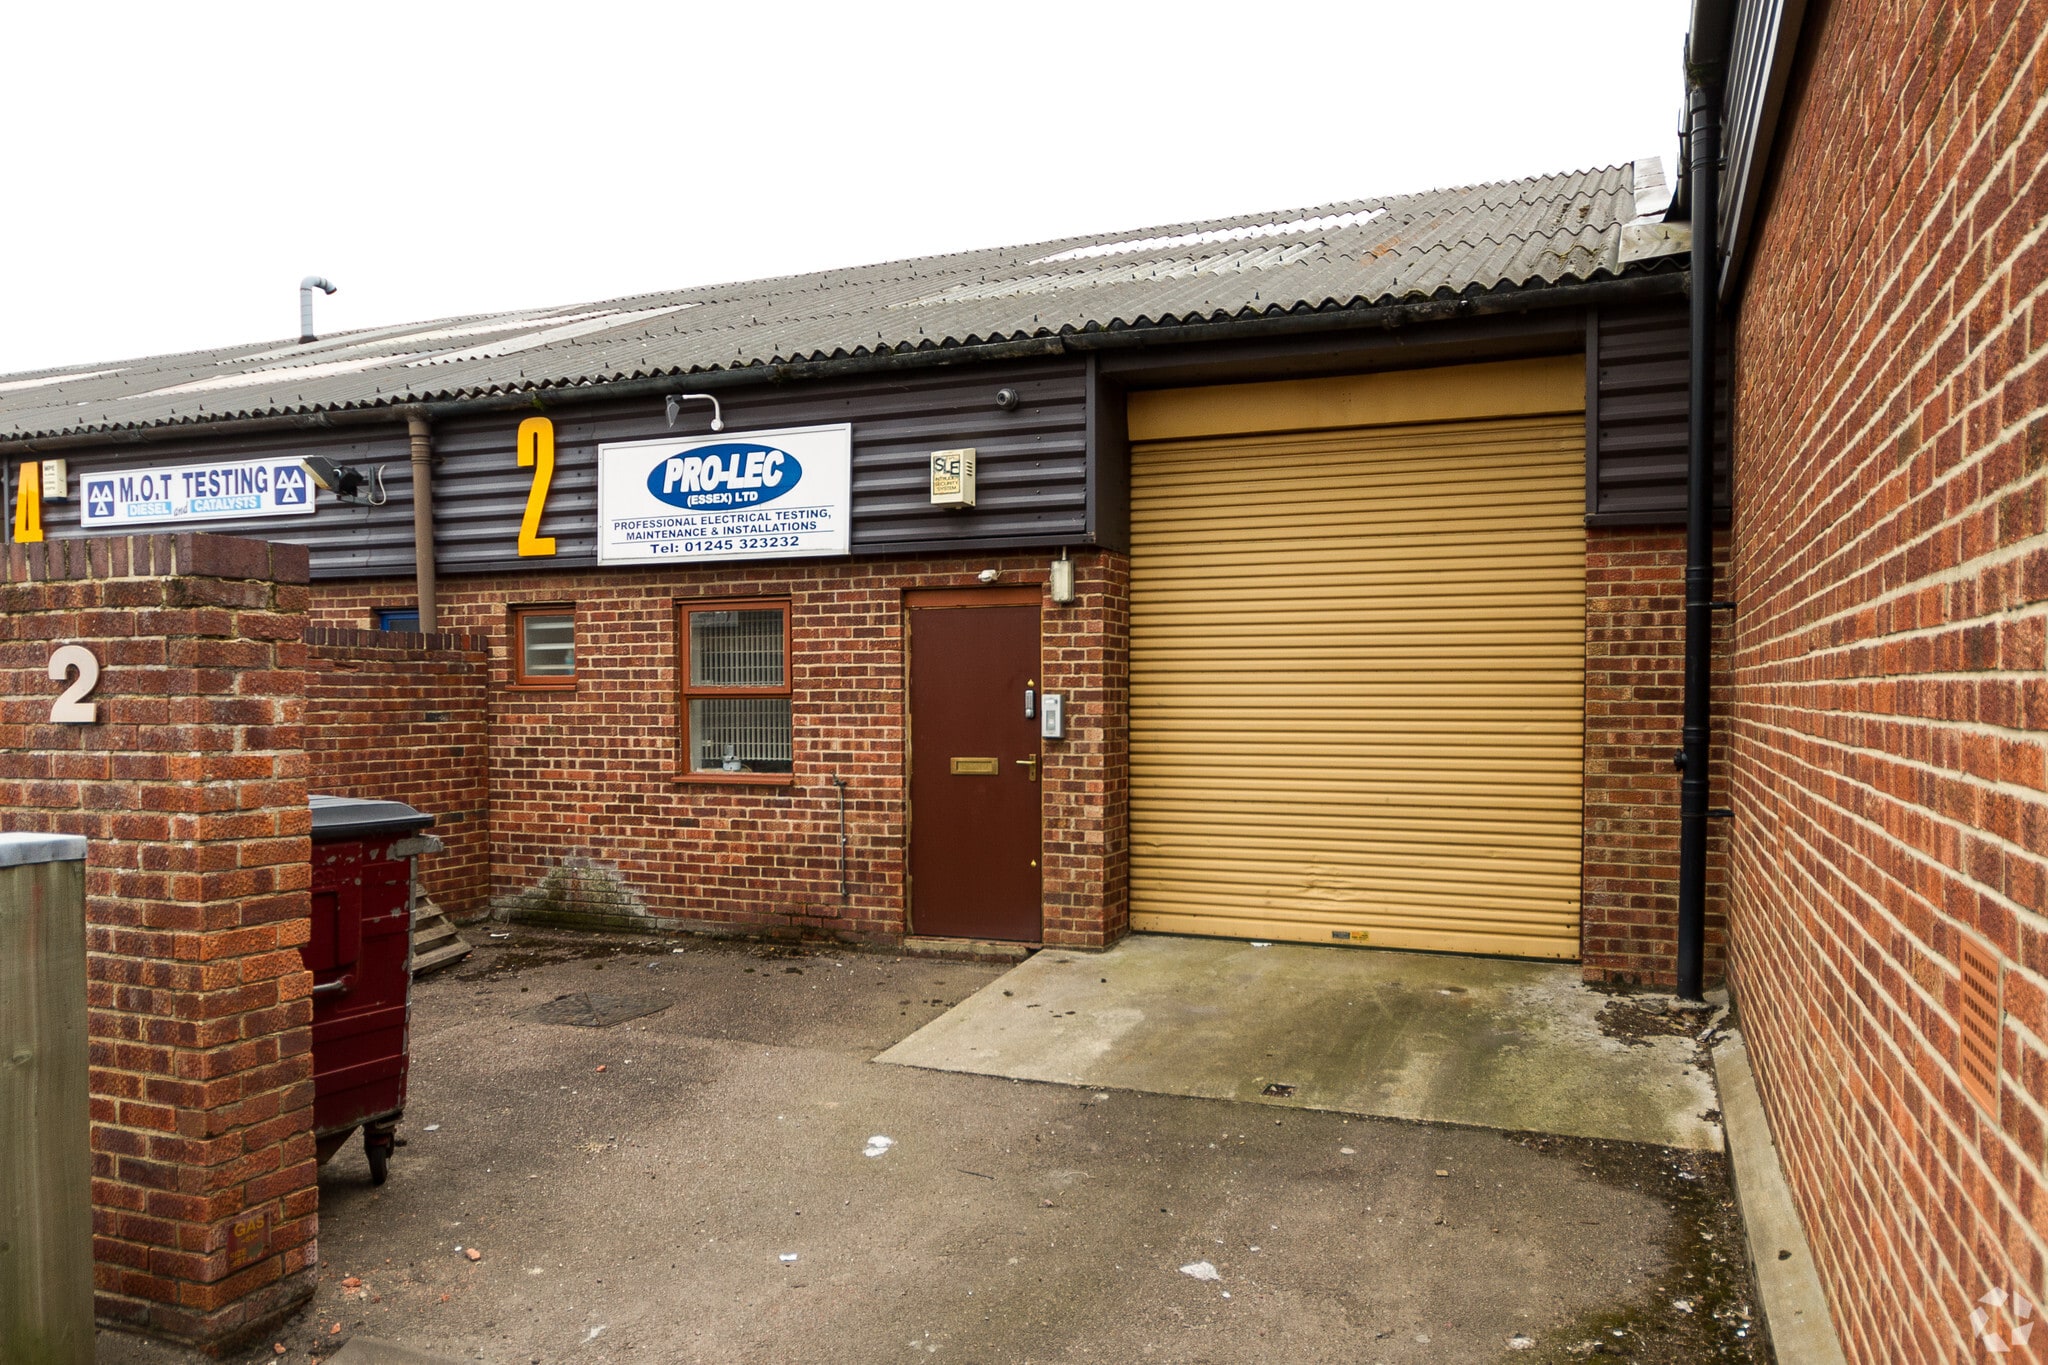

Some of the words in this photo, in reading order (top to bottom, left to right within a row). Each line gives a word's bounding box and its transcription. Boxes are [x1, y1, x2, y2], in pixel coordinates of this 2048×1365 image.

[663, 450, 785, 494] PRO-LEC
[935, 458, 960, 475] SLE
[120, 474, 172, 502] M.O.T
[182, 466, 268, 498] TESTING
[517, 417, 556, 556] 2
[130, 503, 169, 516] DIESEL
[174, 503, 189, 517] and
[194, 498, 257, 512] CATALYSTS
[687, 493, 733, 507] (ESSEX)
[735, 491, 758, 503] LTD
[614, 517, 698, 531] PROFESSIONAL
[701, 513, 772, 525] ELECTRICAL
[775, 508, 832, 521] TESTING,
[626, 528, 707, 541] MAINTENANCE
[712, 527, 719, 536] &
[722, 521, 817, 535] INSTALLATIONS
[650, 542, 679, 554] Tel:
[684, 539, 733, 552] 01245
[739, 535, 800, 550] 323232
[48, 645, 99, 723] 2
[234, 1215, 265, 1237] GAS
